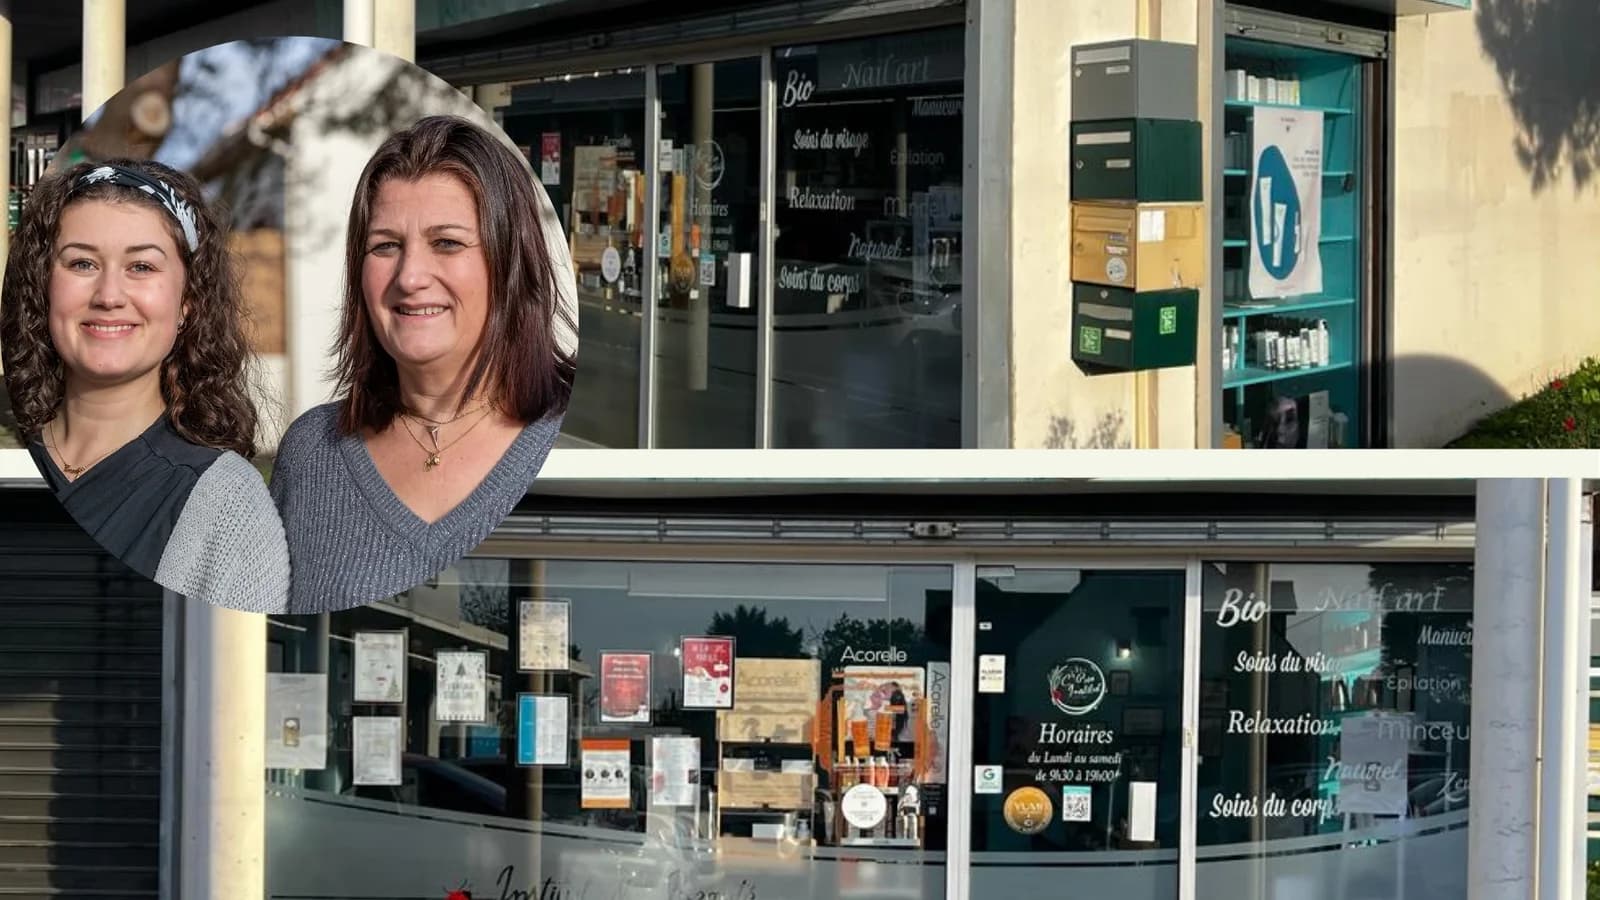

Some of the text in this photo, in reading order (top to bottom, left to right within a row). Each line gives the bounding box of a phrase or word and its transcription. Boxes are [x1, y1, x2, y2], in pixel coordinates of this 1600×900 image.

[783, 69, 816, 107] Bio
[793, 128, 869, 158] Soins du visage
[789, 186, 855, 211] Relaxation
[779, 266, 860, 300] Soins du corps
[1217, 588, 1271, 627] Bio
[840, 646, 908, 662] Acorelle
[1234, 650, 1276, 672] Soins
[1280, 651, 1302, 672] du
[1038, 723, 1113, 744] Horaires
[1227, 710, 1334, 735] Relaxation
[1028, 752, 1121, 764] du Lundi au samedi
[1035, 769, 1047, 781] de
[1049, 769, 1074, 781] 9h30
[1075, 769, 1082, 781] à
[1209, 793, 1341, 824] Soins du corps
